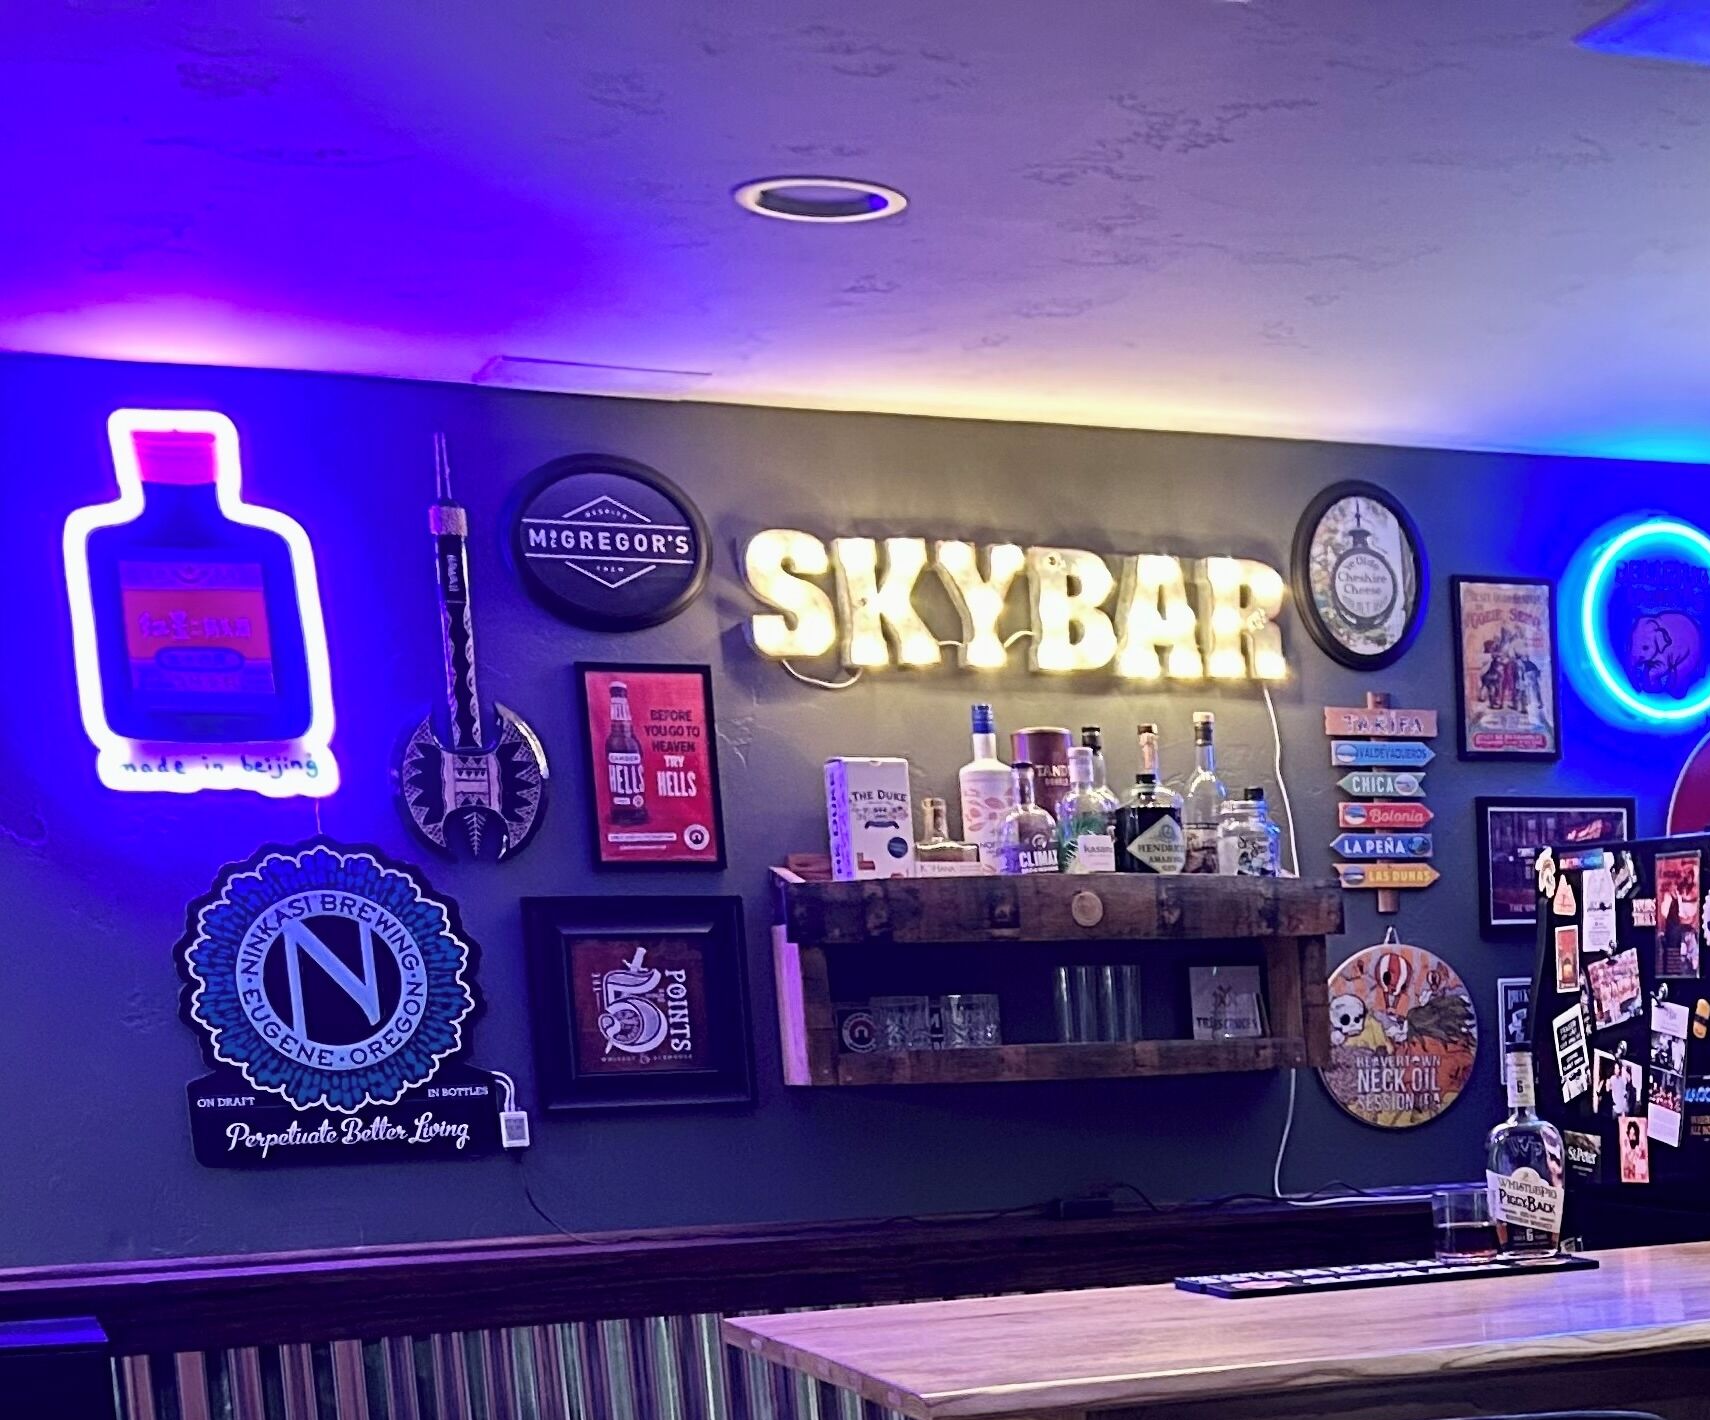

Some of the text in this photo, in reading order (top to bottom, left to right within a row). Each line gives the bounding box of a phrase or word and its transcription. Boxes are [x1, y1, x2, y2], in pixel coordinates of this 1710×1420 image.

[744, 527, 1291, 681] SKYBAR
[650, 708, 692, 722] BEFORE
[1343, 713, 1425, 734] TARIFA
[643, 724, 700, 738] YOU GO TO
[651, 740, 696, 753] HEAVEN
[202, 755, 225, 772] in
[240, 752, 320, 779] beijing
[663, 754, 685, 768] TRY
[608, 764, 645, 795] HELLS
[656, 771, 697, 797] HELLS
[1351, 775, 1395, 793] CHICA
[851, 789, 907, 802] THE DUKE
[1369, 808, 1425, 823] Bolonia
[1344, 837, 1407, 854] LA PEÑA
[1369, 870, 1431, 882] LAS DUNAS
[239, 892, 421, 976] NINKASI BREWING
[664, 967, 693, 1052] POINTS
[241, 980, 425, 1067] EUGENE OREGON
[1356, 1055, 1441, 1068] BEAVERTOWN
[1357, 1067, 1441, 1093] NECK OIL
[1516, 1080, 1524, 1094] 6
[427, 1085, 489, 1098] IN BOTTLES
[196, 1095, 256, 1108] ON DRAFT
[1357, 1093, 1414, 1112] SESSION
[224, 1111, 471, 1160] Perpetuate Better Living
